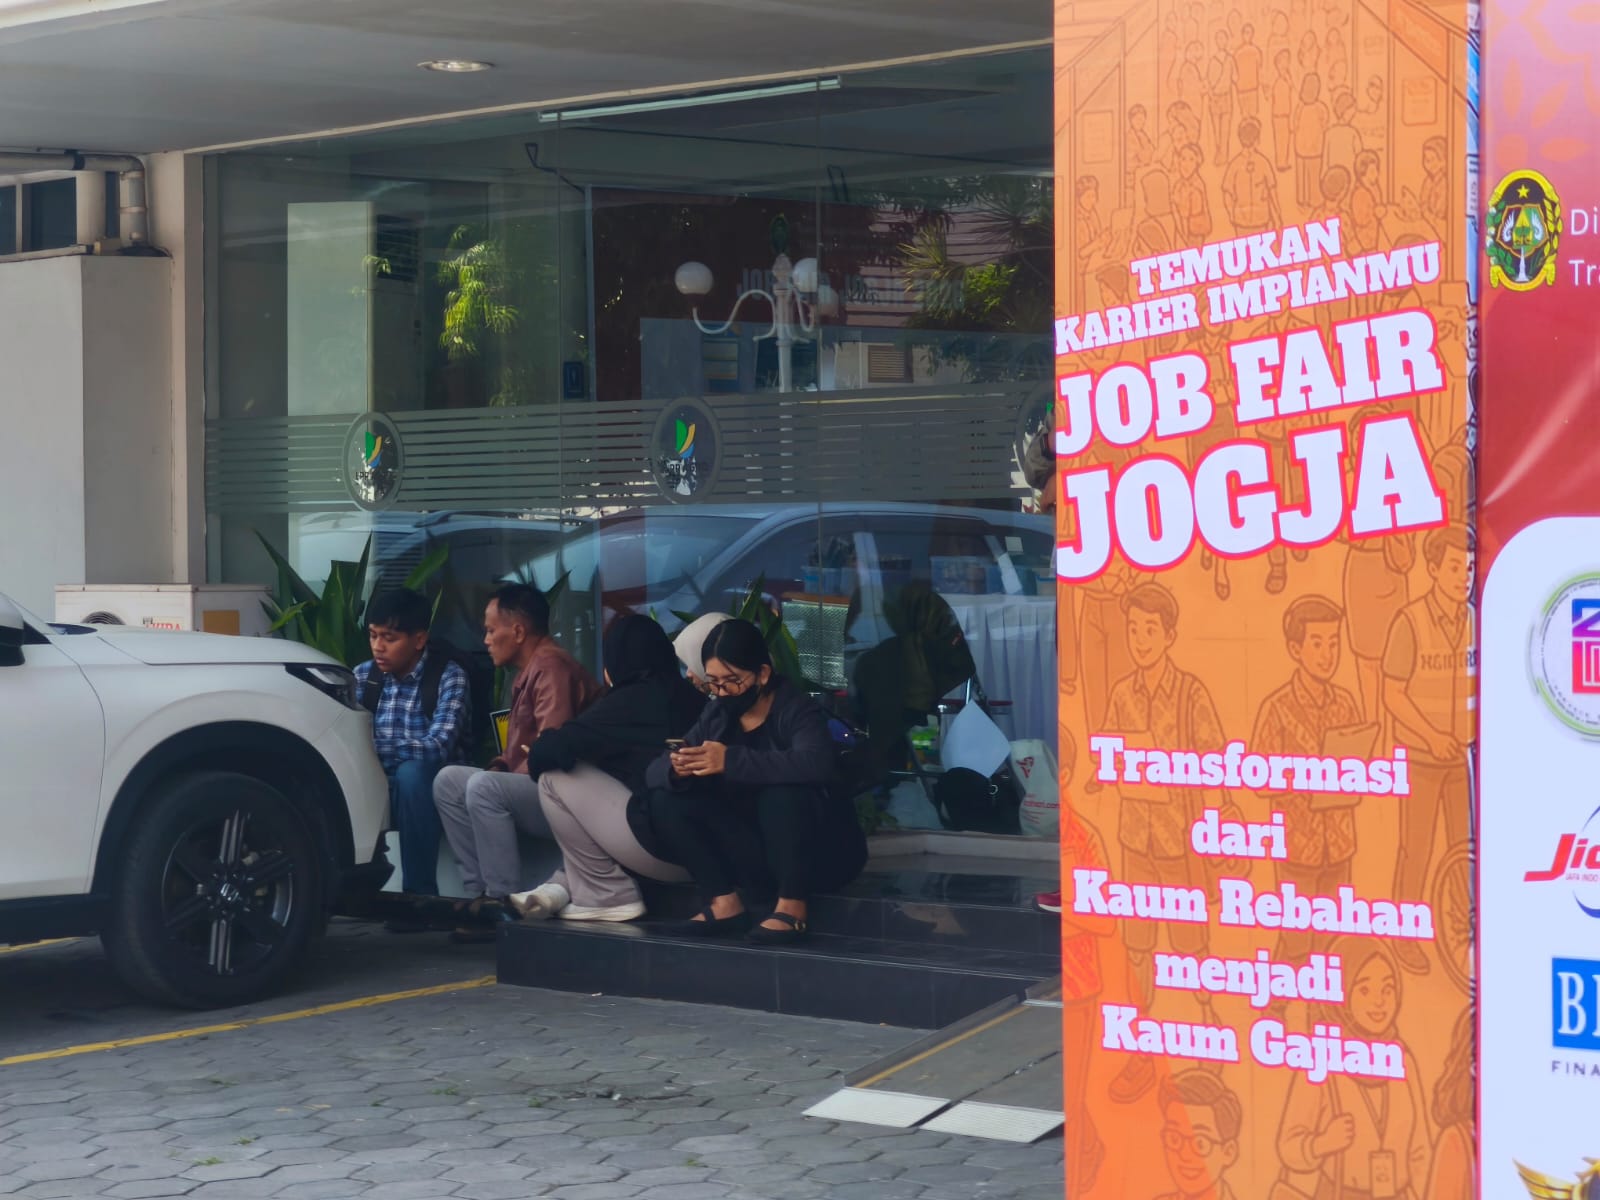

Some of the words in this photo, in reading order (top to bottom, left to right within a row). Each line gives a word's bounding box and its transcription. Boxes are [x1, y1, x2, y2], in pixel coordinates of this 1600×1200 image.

[1130, 218, 1341, 295] TEMUKAN
[1568, 259, 1600, 287] Tr
[1055, 293, 1200, 355] KARIER
[1206, 242, 1440, 324] IMPIANMU
[1055, 354, 1213, 455] JOB
[1230, 311, 1443, 422] FAIR
[1056, 417, 1443, 578] JOGJA
[1090, 736, 1410, 795] Transformasi
[1191, 809, 1287, 858] dari
[1073, 869, 1208, 922] Kaum
[1219, 879, 1434, 939] Rebahan
[1155, 950, 1344, 1007] menjadi
[1102, 1005, 1239, 1061] Kaum
[1250, 1020, 1405, 1082] Gajian
